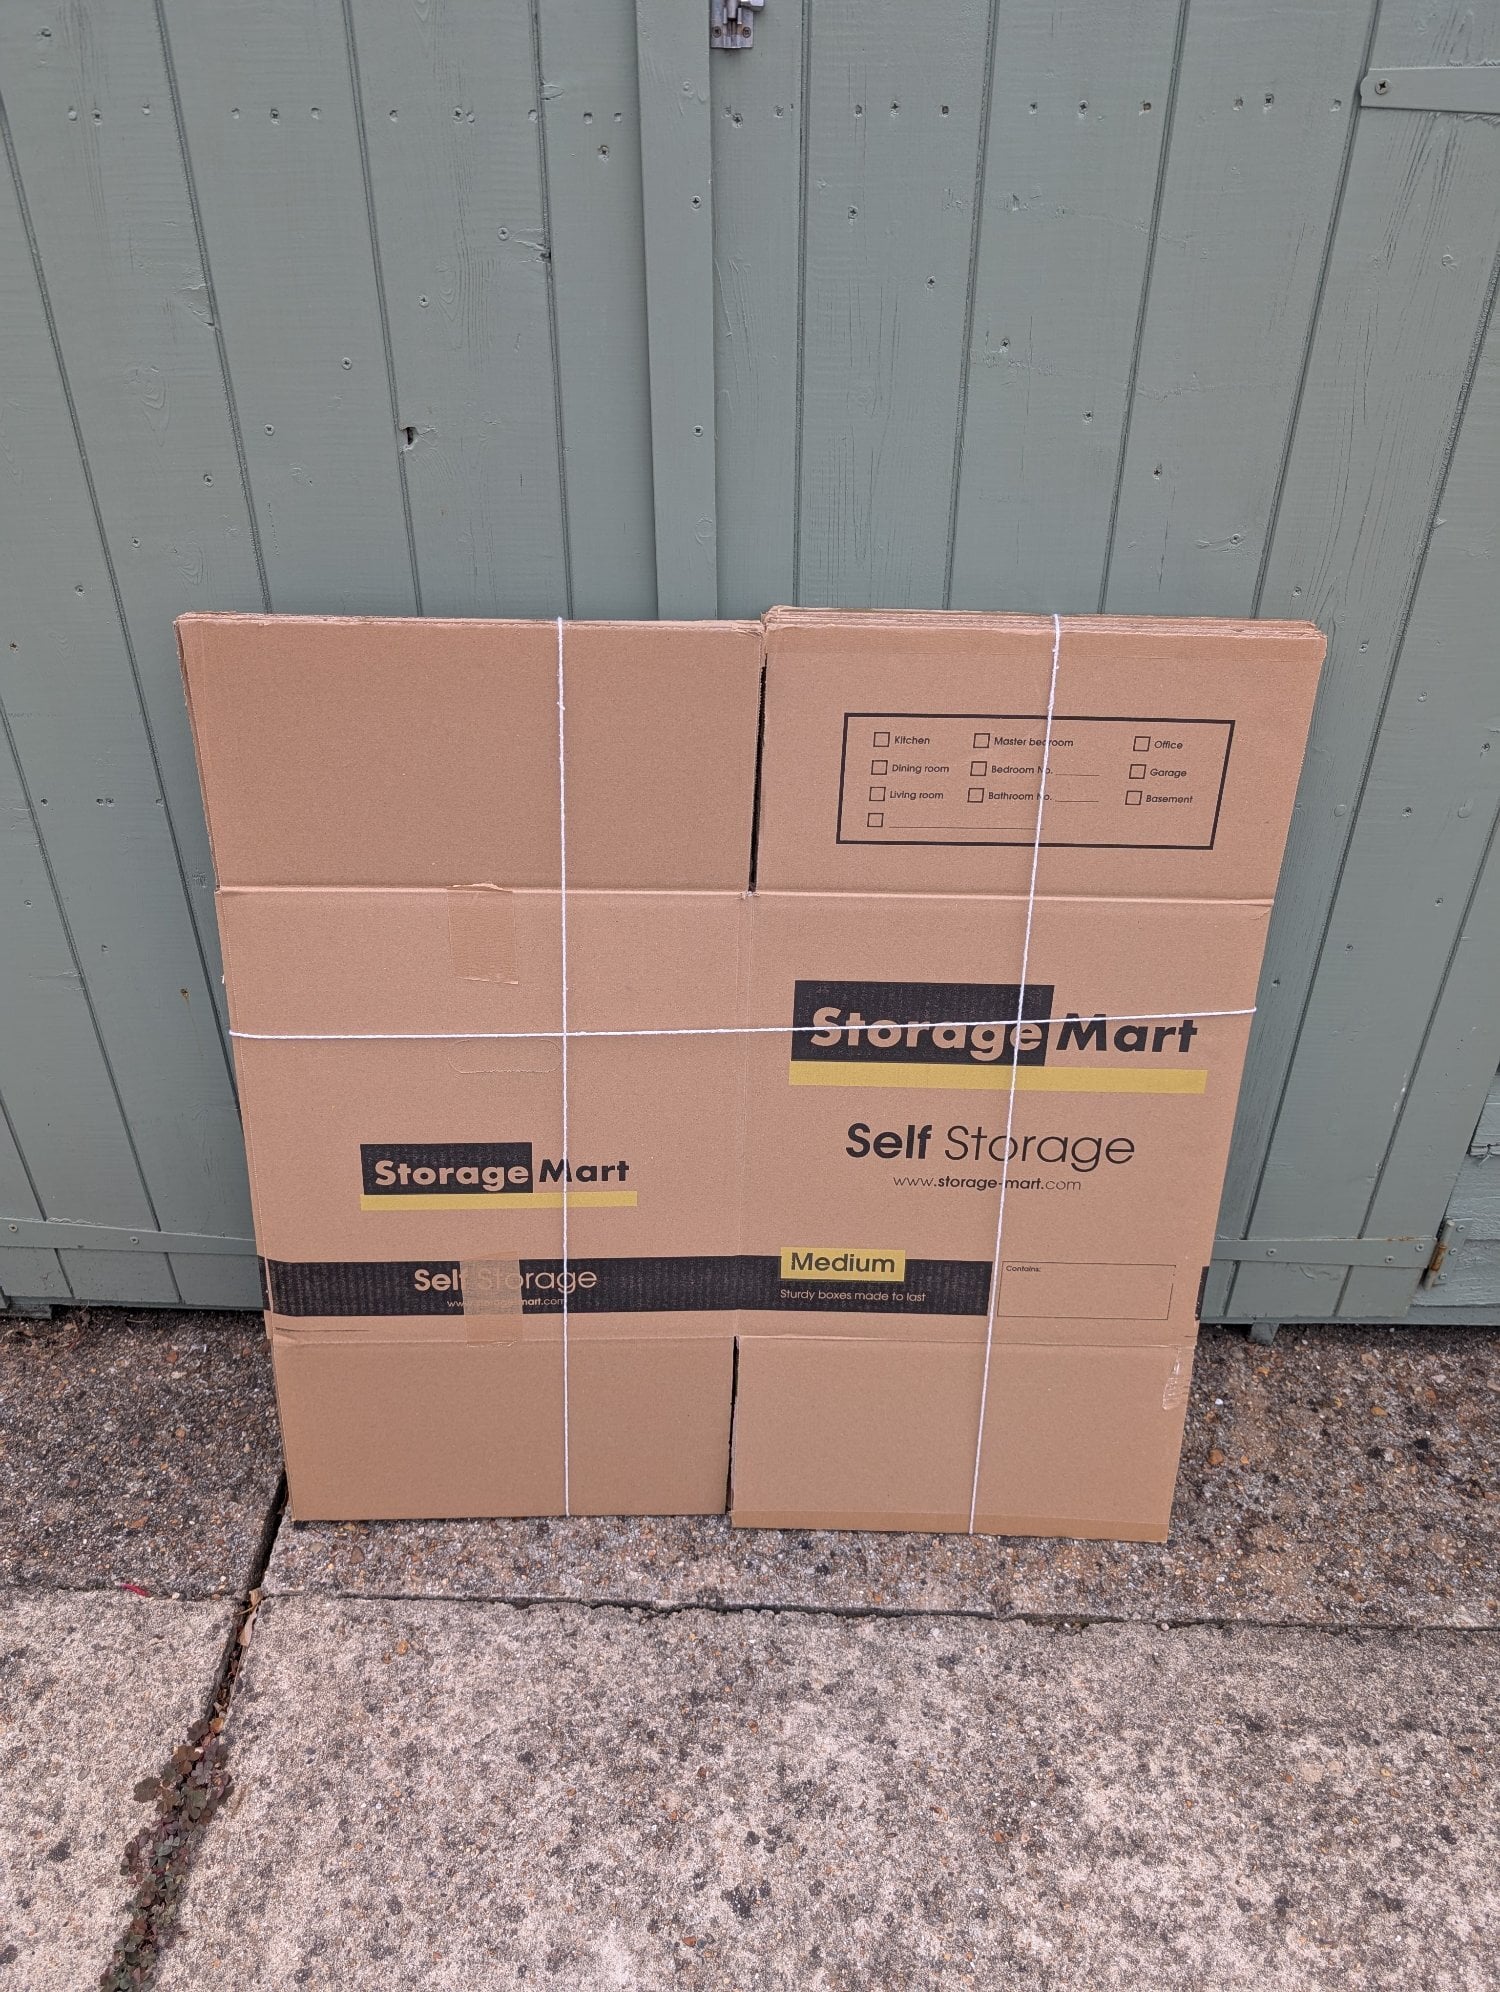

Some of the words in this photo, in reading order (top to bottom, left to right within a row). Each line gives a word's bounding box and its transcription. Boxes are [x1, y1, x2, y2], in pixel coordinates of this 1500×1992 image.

[894, 735, 931, 745] Kitchen
[993, 737, 1027, 746] Master
[1154, 740, 1183, 749] Office
[892, 764, 922, 774] Dining
[924, 765, 950, 773] room
[991, 765, 1035, 774] Bedroom
[1149, 768, 1187, 778] Garage
[889, 790, 917, 801] Living
[918, 791, 944, 799] room
[988, 791, 1034, 801] Bathroom
[1145, 794, 1193, 804] Basement
[810, 1006, 1043, 1062] Storage
[1056, 1012, 1198, 1053] Mart
[845, 1122, 932, 1160] Self
[944, 1125, 1135, 1173] Storage
[374, 1160, 529, 1192] Storage
[539, 1158, 630, 1182] Mart
[893, 1175, 1082, 1192] www.storage-mart.com
[790, 1252, 895, 1273] Medium
[1006, 1265, 1041, 1273] Contains:
[780, 1289, 815, 1301] Sturdy
[818, 1290, 852, 1300] boxes
[854, 1291, 888, 1301] made
[891, 1292, 904, 1302] to
[906, 1292, 926, 1302] last
